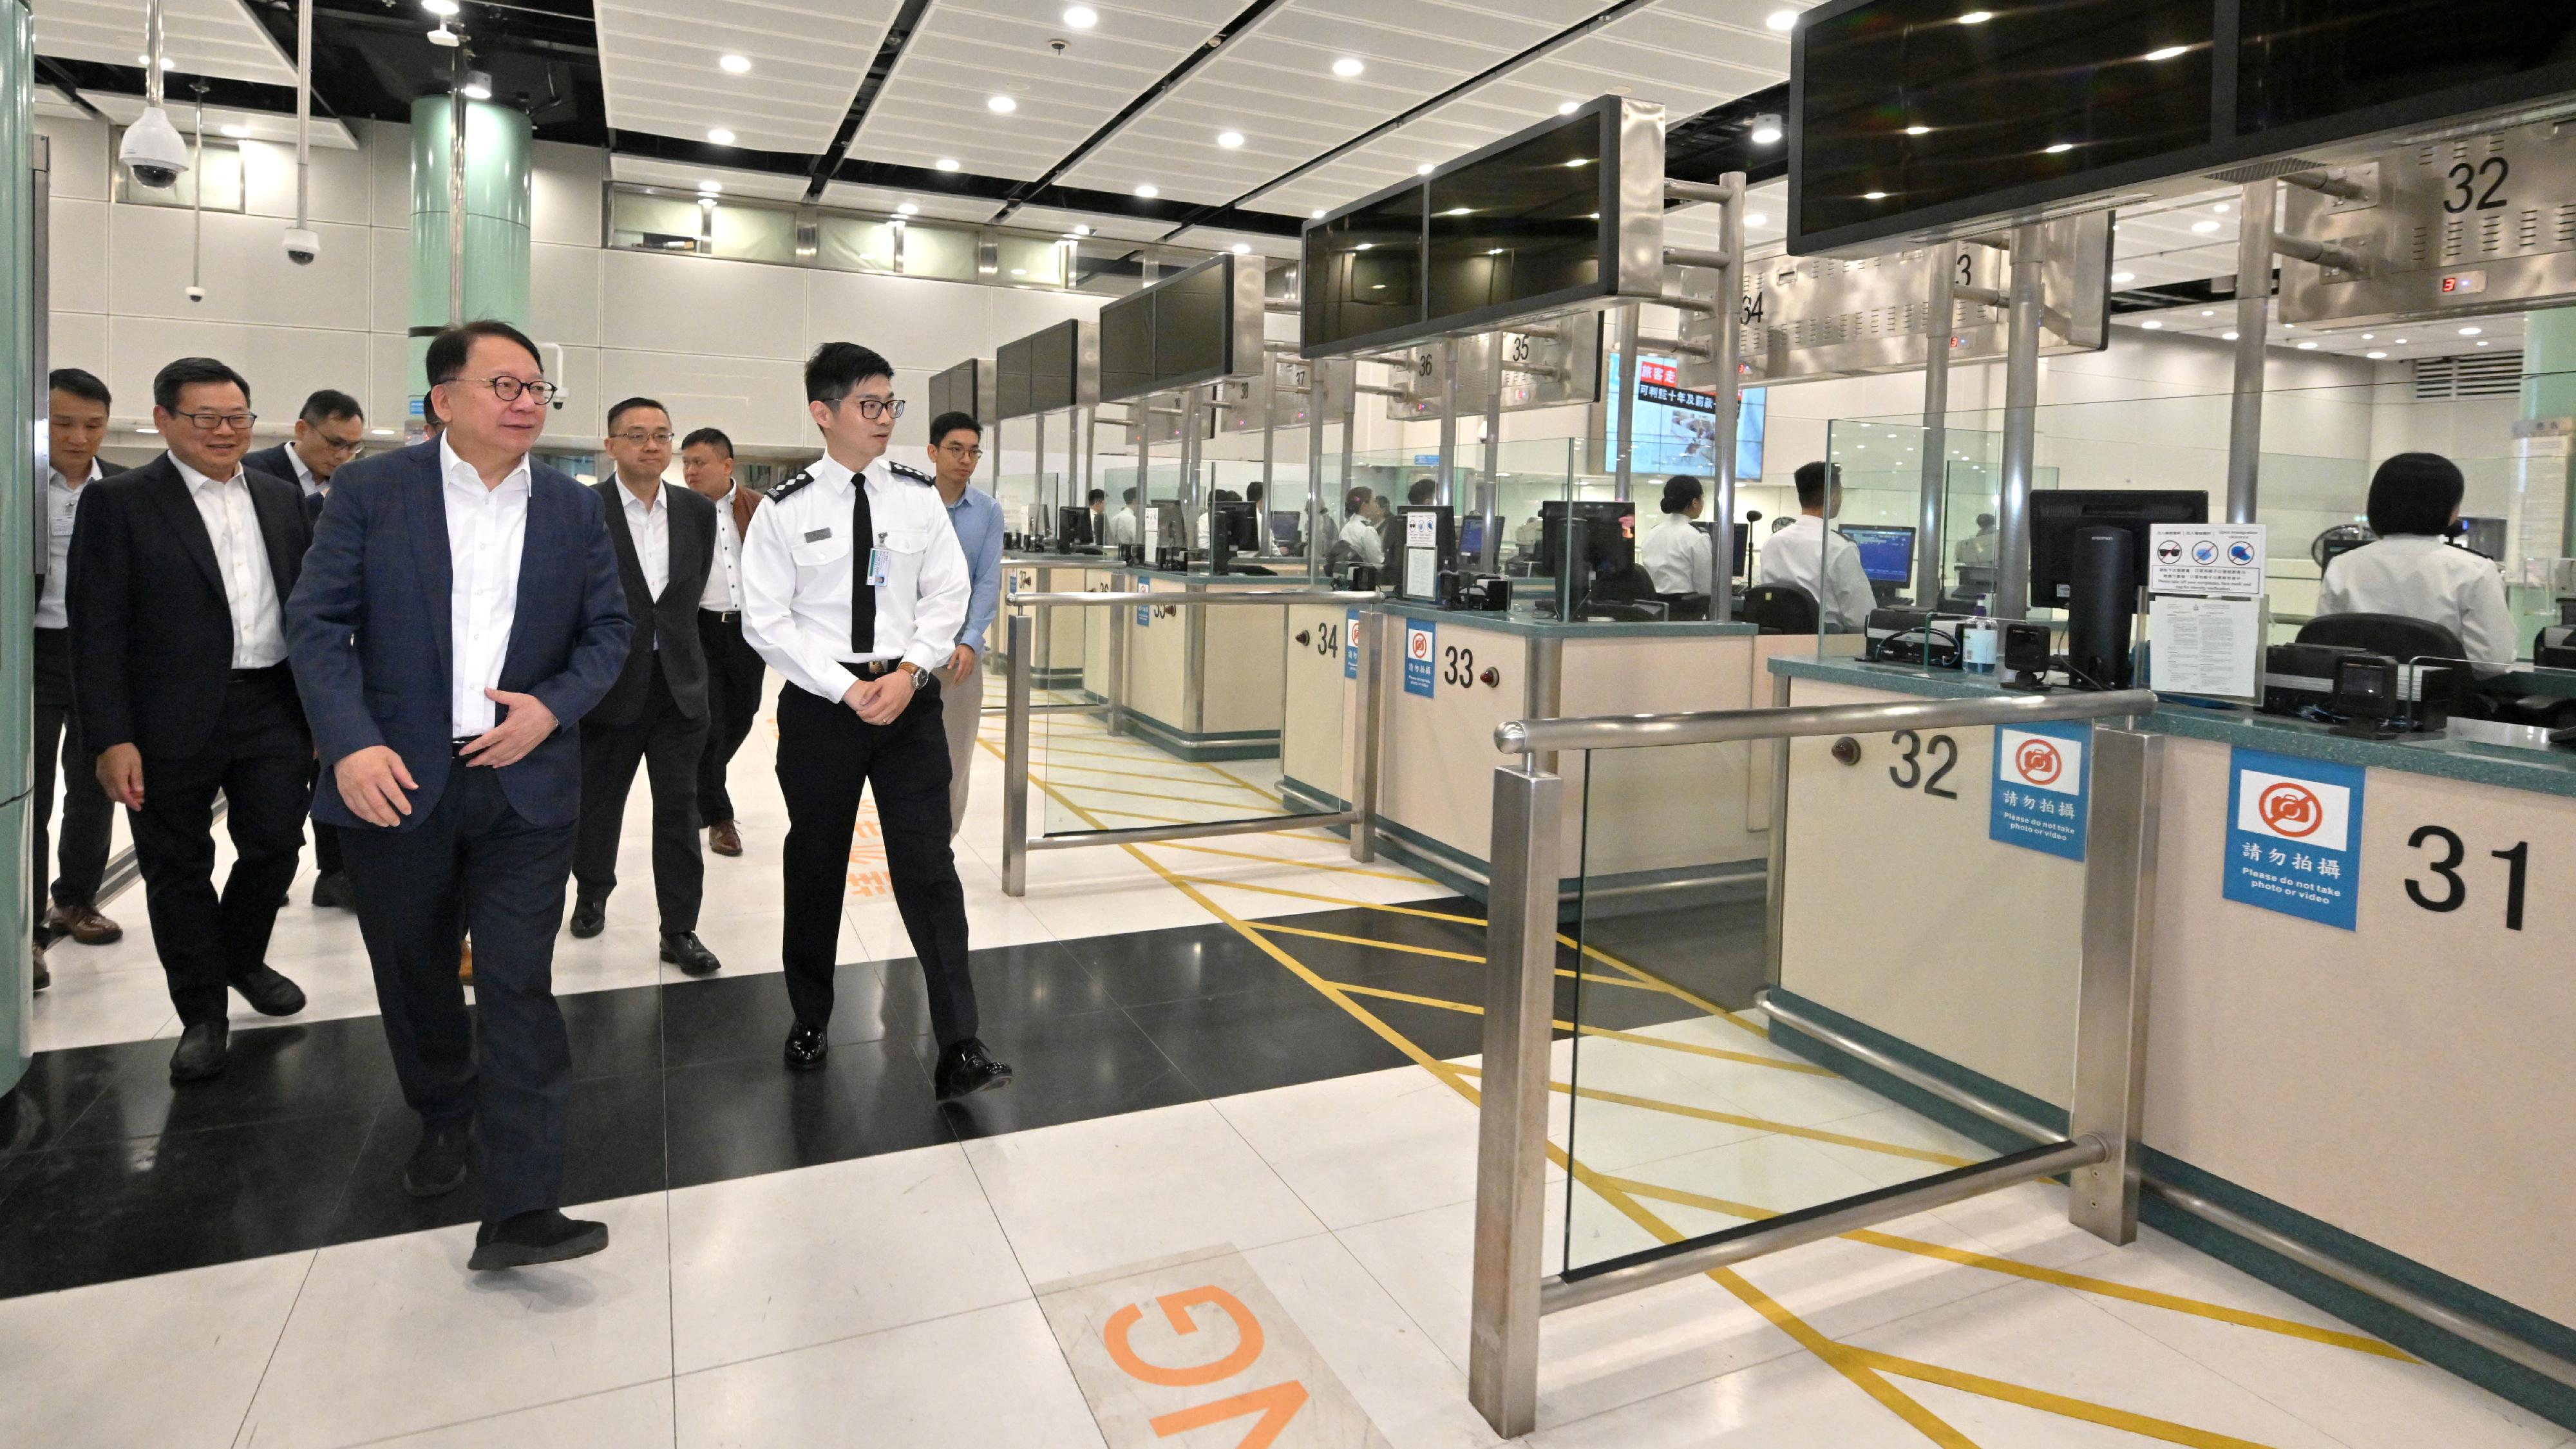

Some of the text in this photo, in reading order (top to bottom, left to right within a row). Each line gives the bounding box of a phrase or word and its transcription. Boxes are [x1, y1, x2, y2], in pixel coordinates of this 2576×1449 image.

[2443, 156, 2509, 213] 32
[1740, 292, 1764, 325] 34
[1513, 336, 1530, 361] 35
[1419, 354, 1432, 376] 36
[1642, 365, 1676, 383] 旅客走
[1640, 384, 1716, 409] 可判監十年及罰款
[1318, 622, 1338, 659] 34
[1444, 645, 1473, 688] 33
[1889, 729, 1958, 800] 32
[2003, 790, 2076, 820] 請勿拍攝
[2003, 811, 2030, 824] Please
[2058, 826, 2075, 835] take
[2010, 822, 2033, 833] photo
[2044, 831, 2067, 840] video
[2241, 842, 2342, 880] 請勿拍攝
[2242, 867, 2341, 897] Please do not take
[2251, 880, 2282, 893] photo
[2298, 891, 2330, 904] video
[2404, 825, 2528, 931] 31
